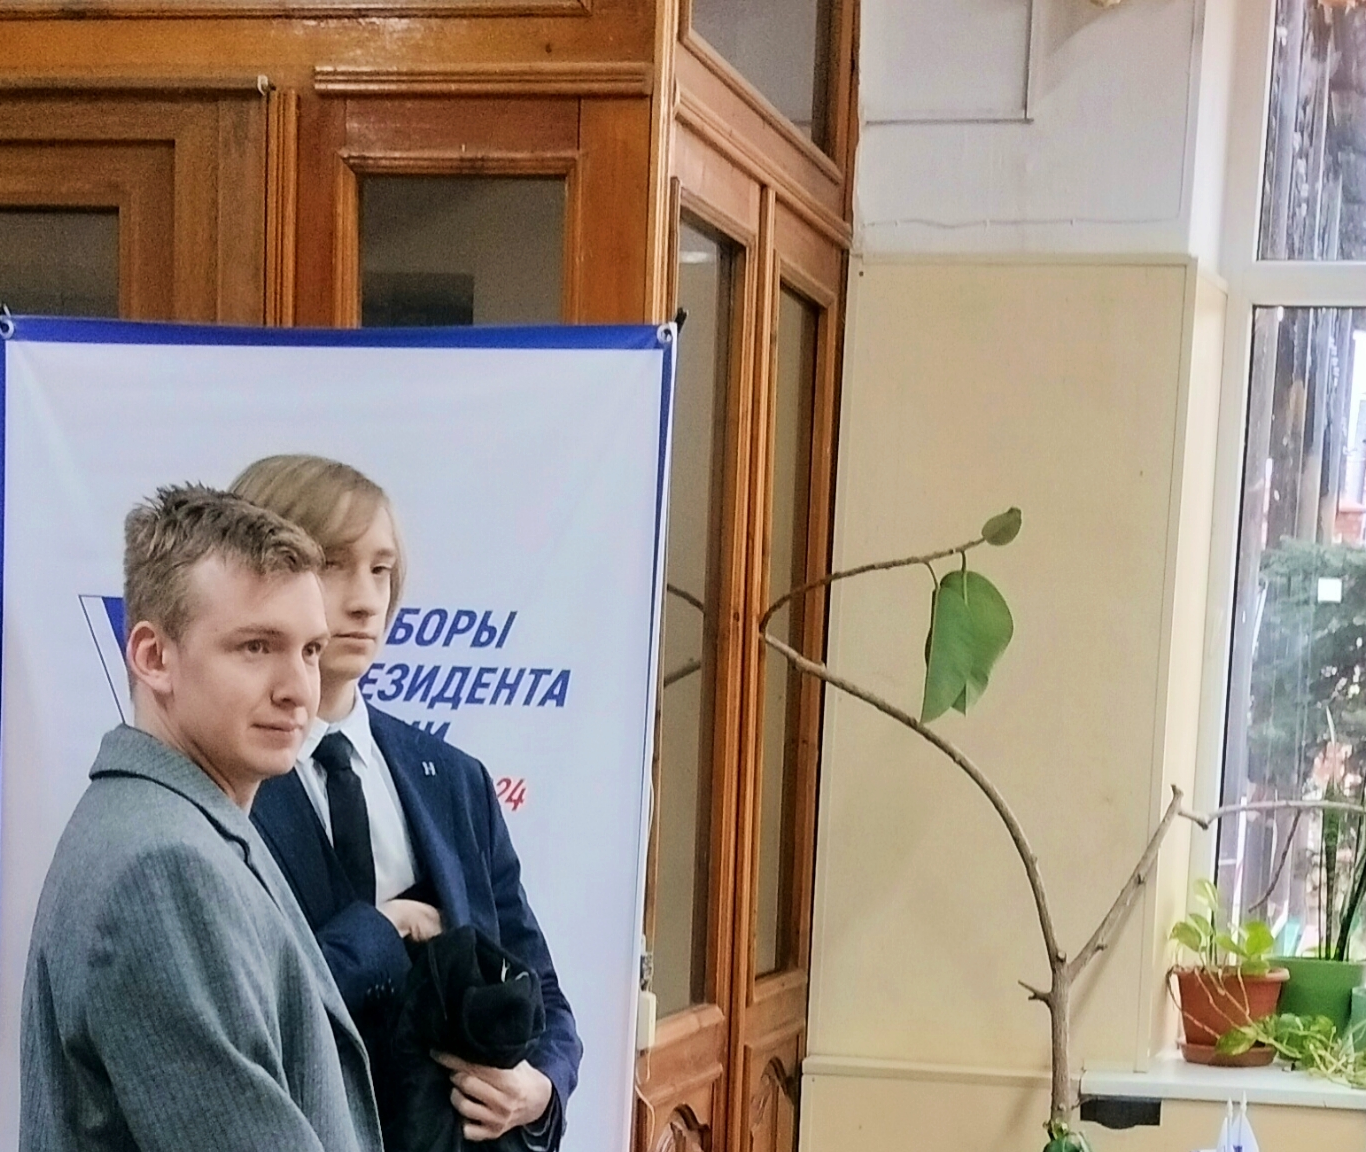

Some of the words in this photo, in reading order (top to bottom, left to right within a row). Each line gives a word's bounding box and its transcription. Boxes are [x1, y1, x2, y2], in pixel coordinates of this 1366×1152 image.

[386, 607, 518, 649] БОРЫ
[358, 663, 572, 710] ЕЗИДЕНТА
[496, 778, 527, 812] 24
